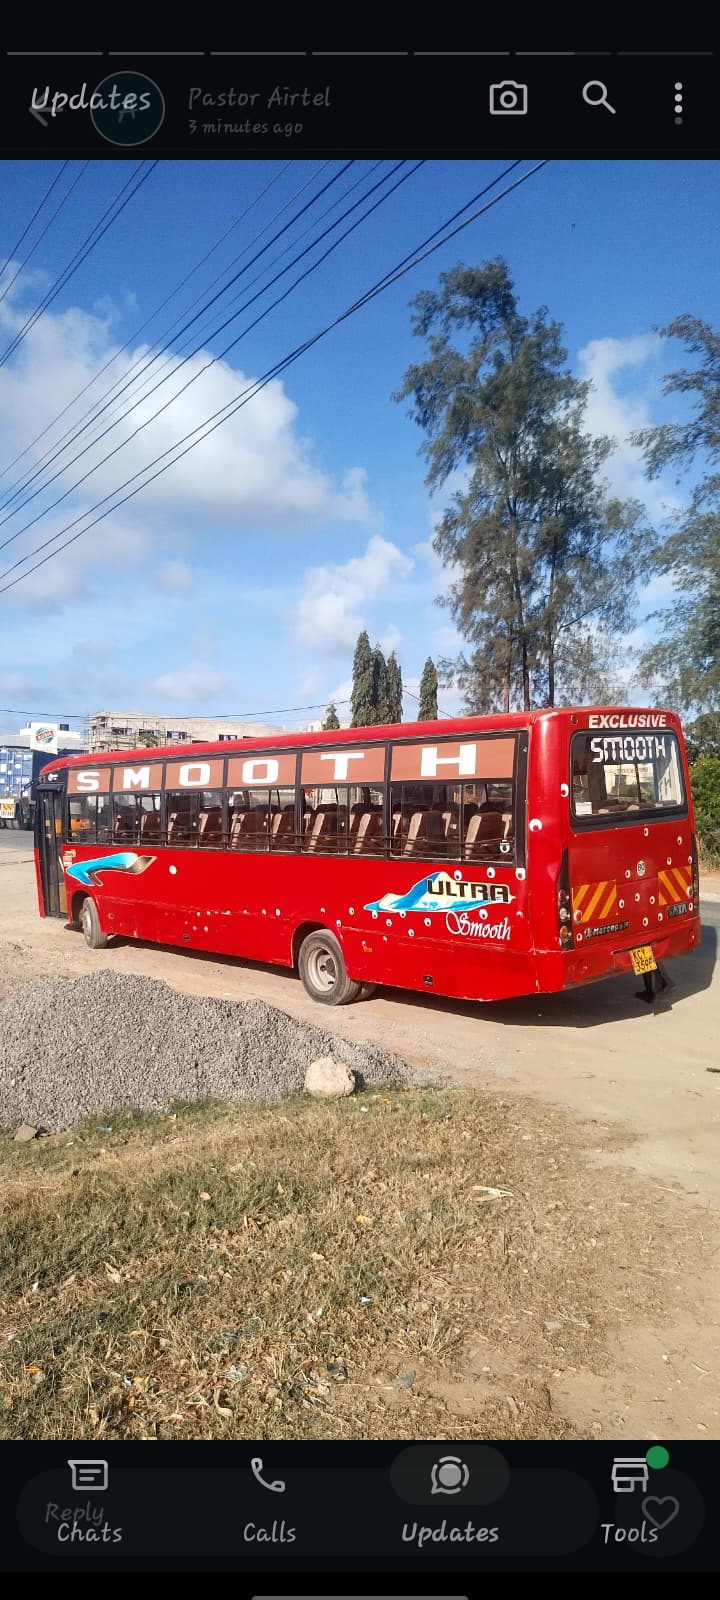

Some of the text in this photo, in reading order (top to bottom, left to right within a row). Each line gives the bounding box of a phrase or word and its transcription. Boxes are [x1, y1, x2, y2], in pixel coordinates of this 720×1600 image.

[588, 714, 667, 729] EXCLUSIVE
[590, 735, 666, 763] SMOOTH
[427, 879, 509, 903] ULTRA
[445, 911, 511, 941] Smooth
